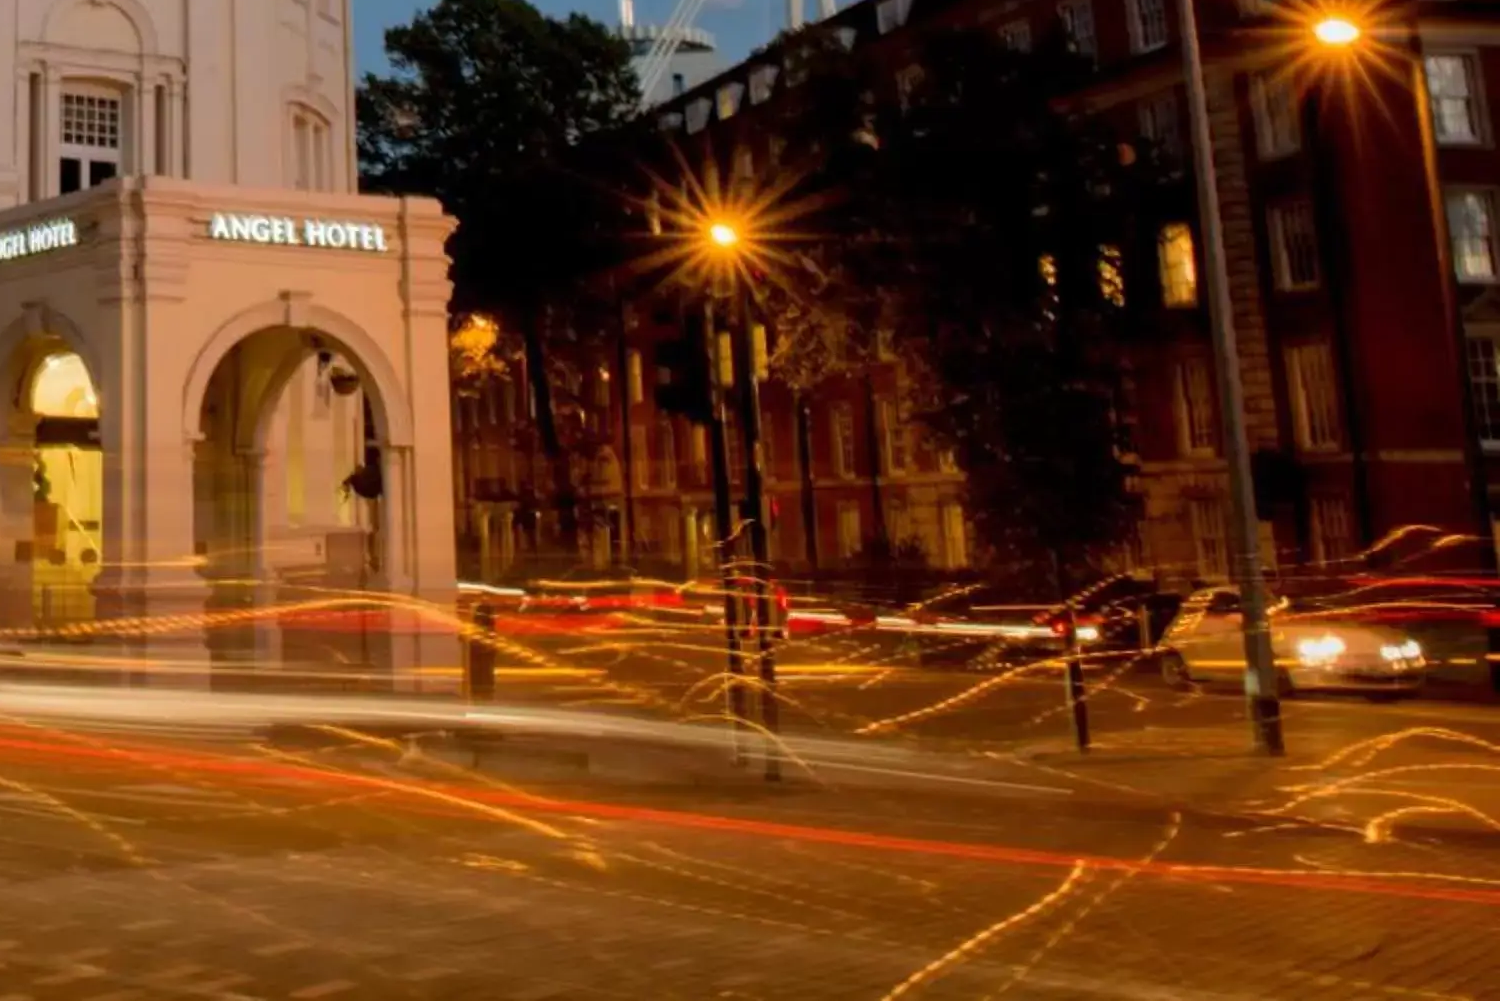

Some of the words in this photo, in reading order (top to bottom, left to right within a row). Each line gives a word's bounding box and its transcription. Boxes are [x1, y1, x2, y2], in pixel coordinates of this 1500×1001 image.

[28, 220, 77, 253] HOTEL
[211, 212, 299, 245] ANGEL
[304, 219, 388, 252] HOTEL
